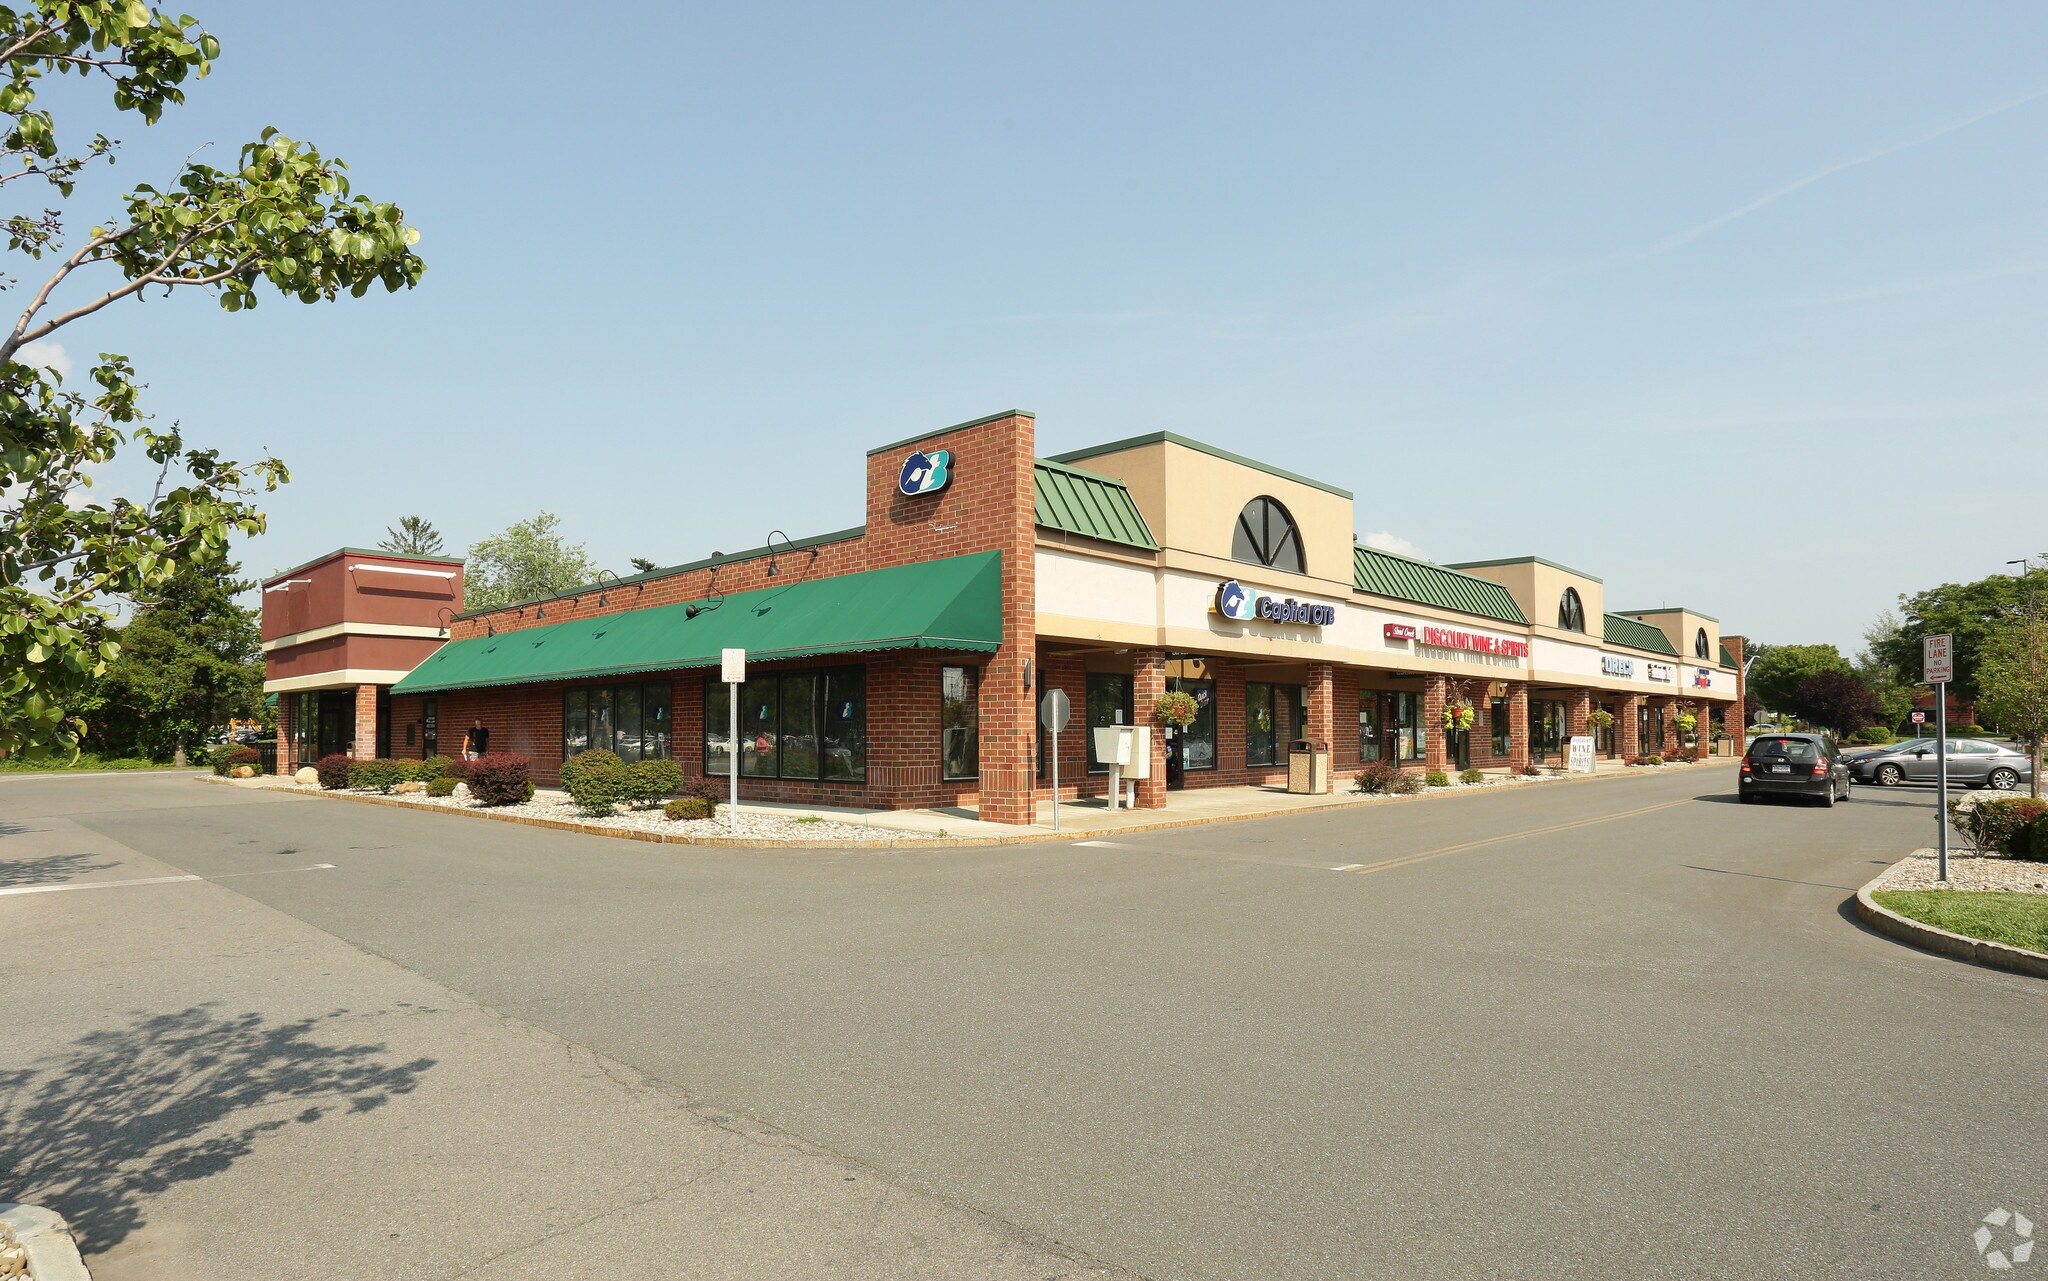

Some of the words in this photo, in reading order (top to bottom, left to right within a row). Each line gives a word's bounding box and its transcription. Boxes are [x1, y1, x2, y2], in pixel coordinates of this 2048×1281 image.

[1259, 596, 1310, 624] Capital
[1312, 604, 1335, 626] OTB
[1424, 626, 1471, 650] DISCOUNT
[1471, 633, 1493, 654] WINE
[1495, 637, 1502, 655] &
[1501, 639, 1529, 658] SPIRITS
[1929, 638, 1946, 648] FIRE
[1928, 648, 1947, 658] LANE
[1926, 665, 1950, 675] PARKING
[1572, 745, 1591, 753] WINE
[1570, 756, 1590, 767] SPIRITS
